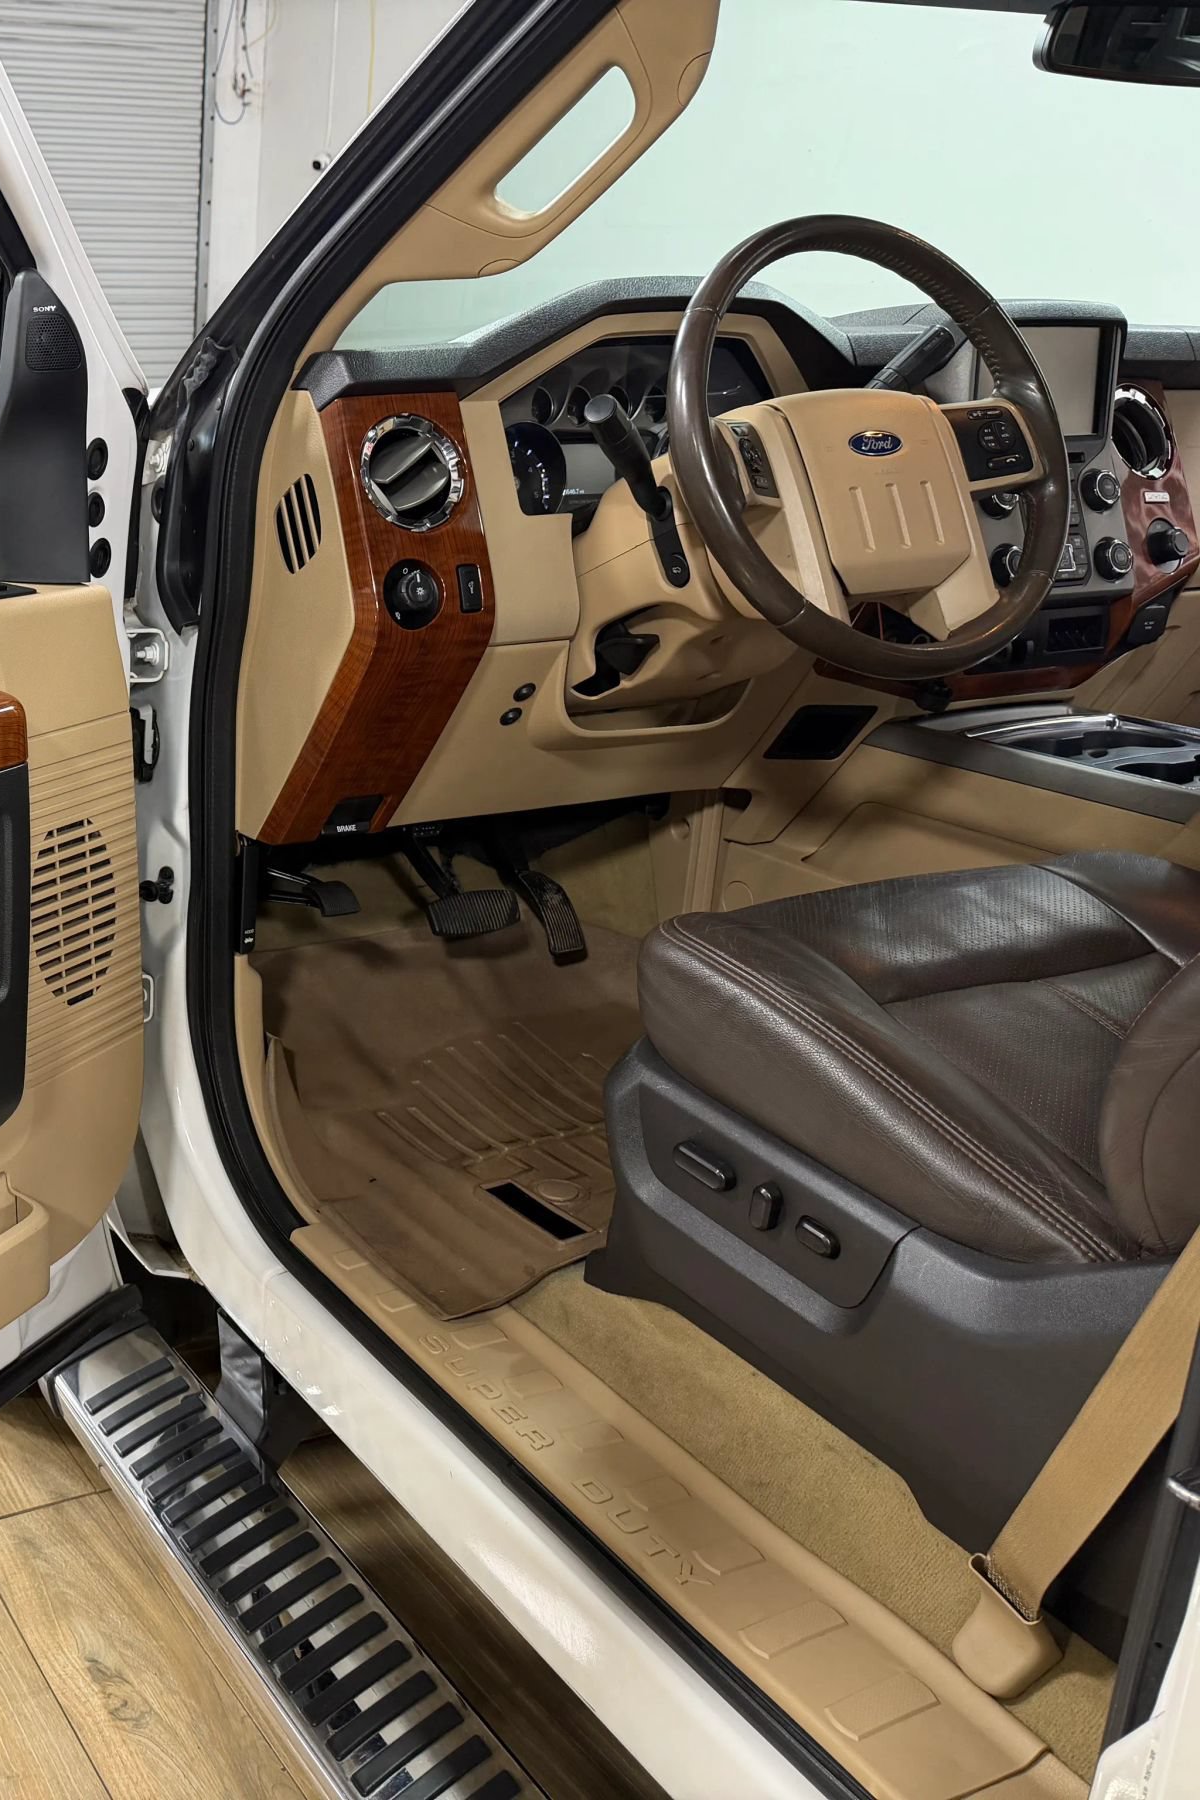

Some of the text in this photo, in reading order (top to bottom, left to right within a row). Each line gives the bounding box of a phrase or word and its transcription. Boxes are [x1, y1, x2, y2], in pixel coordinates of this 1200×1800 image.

[861, 436, 893, 451] Ford
[336, 824, 358, 833] BRAKE
[418, 1334, 716, 1586] SUPER DUTY
